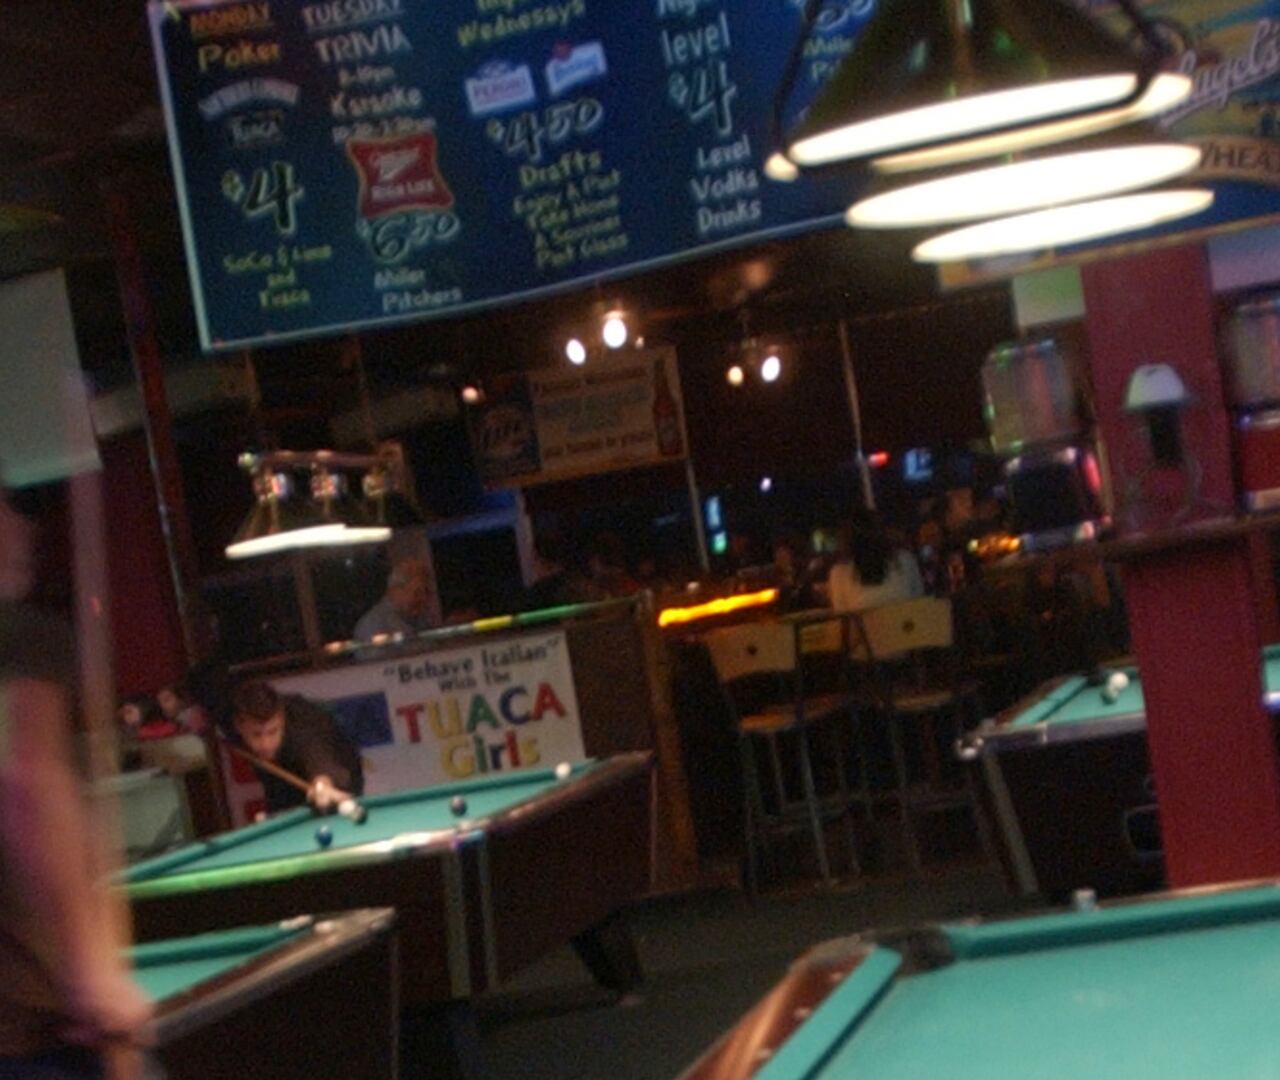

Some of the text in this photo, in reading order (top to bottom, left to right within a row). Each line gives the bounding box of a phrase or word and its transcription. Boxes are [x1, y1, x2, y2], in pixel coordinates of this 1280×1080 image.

[197, 40, 280, 71] Poker
[314, 24, 413, 62] TRIVIA
[662, 12, 730, 64] level
[331, 88, 422, 117] Karaoke
[669, 60, 737, 136] $4
[521, 151, 602, 187] Drafts
[697, 134, 751, 169] Level
[222, 161, 305, 234] $4
[690, 169, 760, 200] Vodka
[697, 200, 762, 234] Drinks
[382, 286, 463, 313] Pitchers
[396, 682, 566, 743] TUACA
[441, 730, 541, 778] Girls
